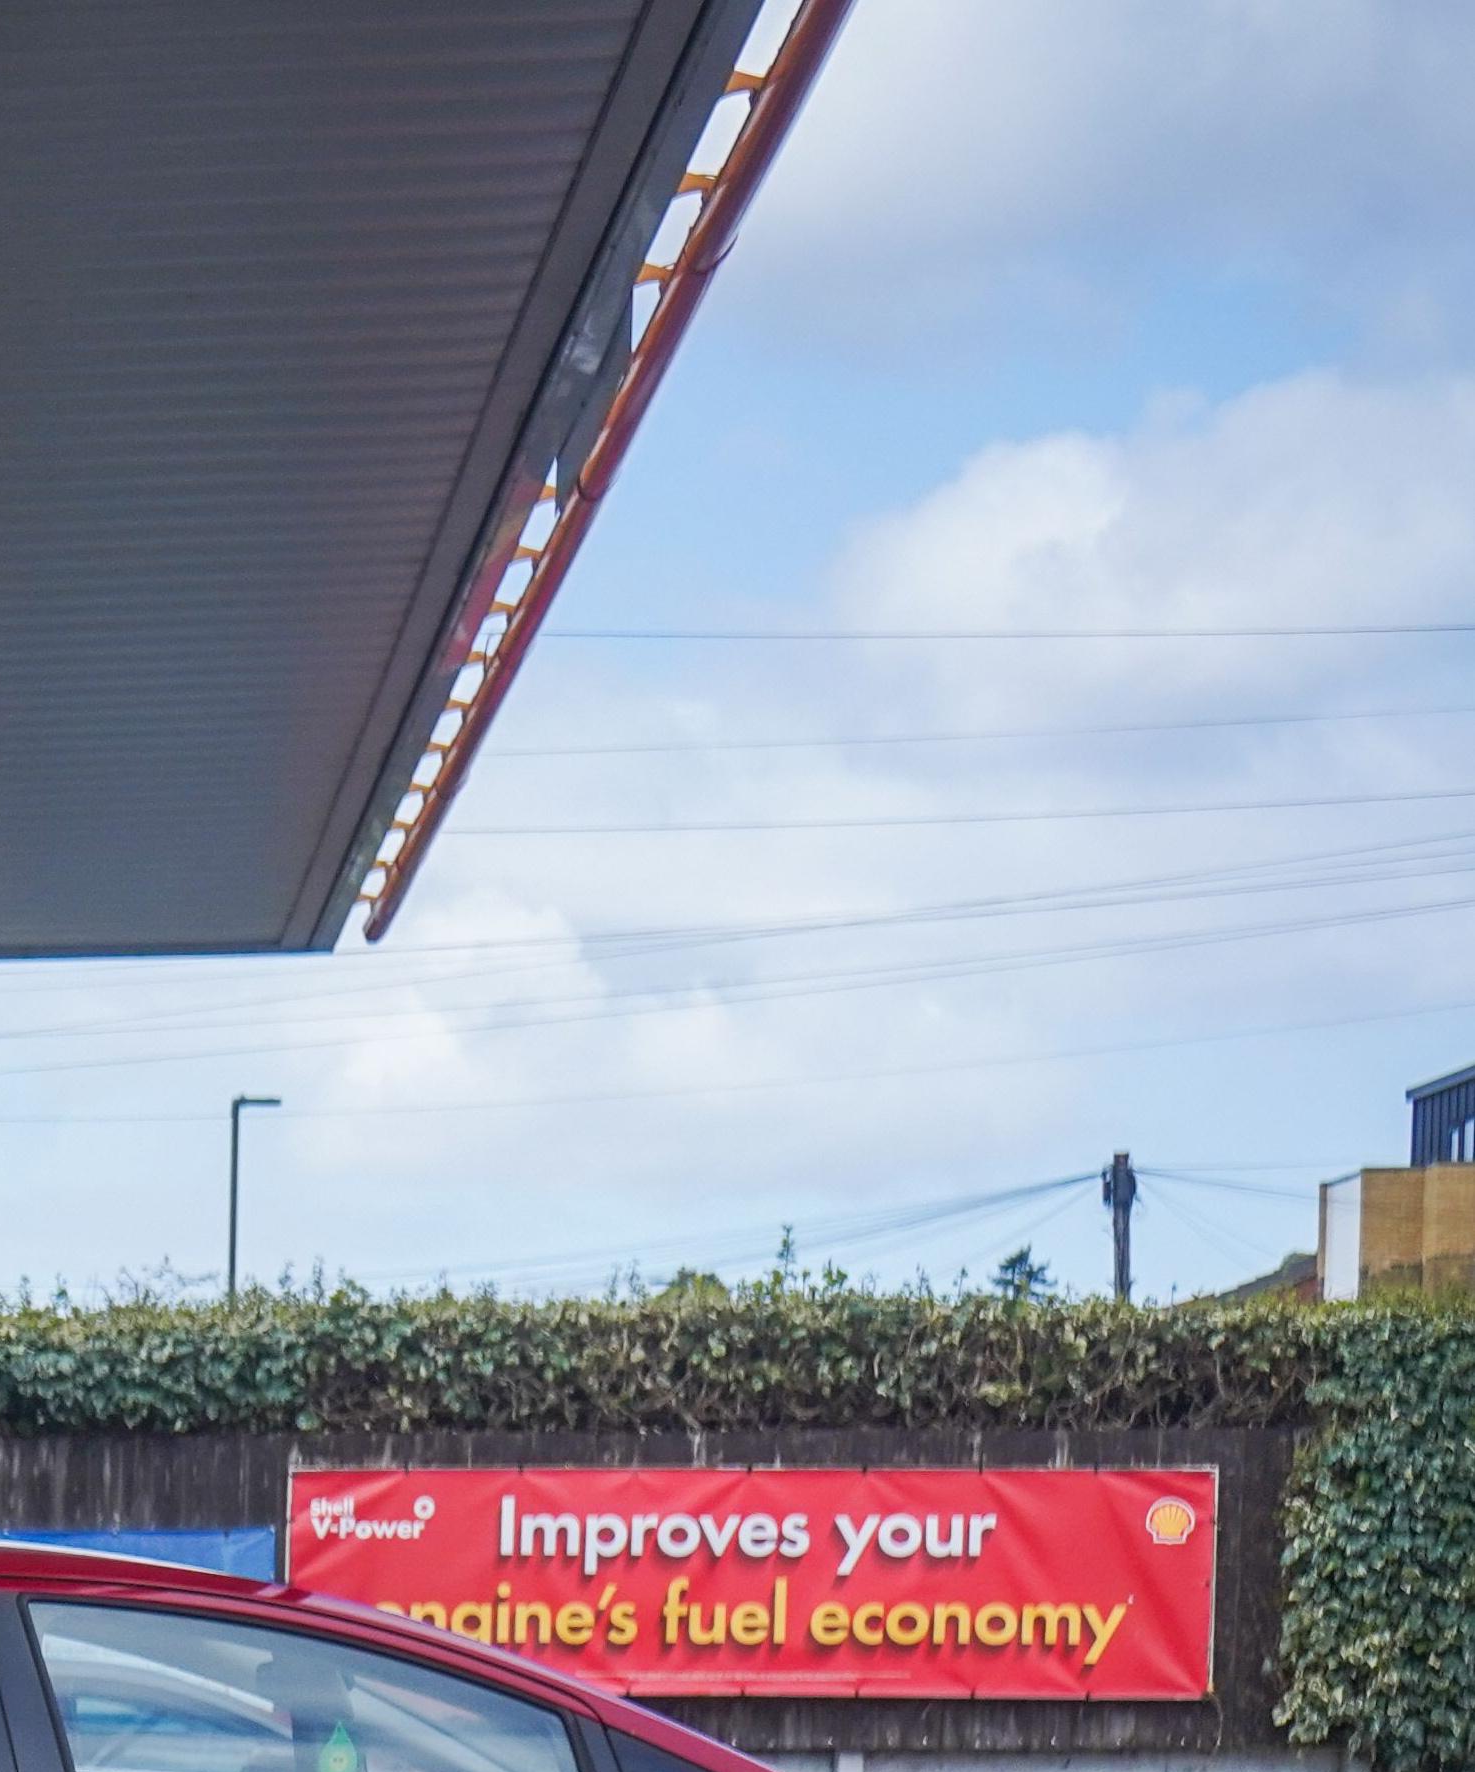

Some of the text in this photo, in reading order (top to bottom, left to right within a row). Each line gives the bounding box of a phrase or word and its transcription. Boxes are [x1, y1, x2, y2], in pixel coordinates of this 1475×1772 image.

[310, 1496, 355, 1517] Shell
[311, 1516, 425, 1541] V-Power
[500, 1494, 997, 1577] Improves your
[663, 1577, 788, 1648] fuel
